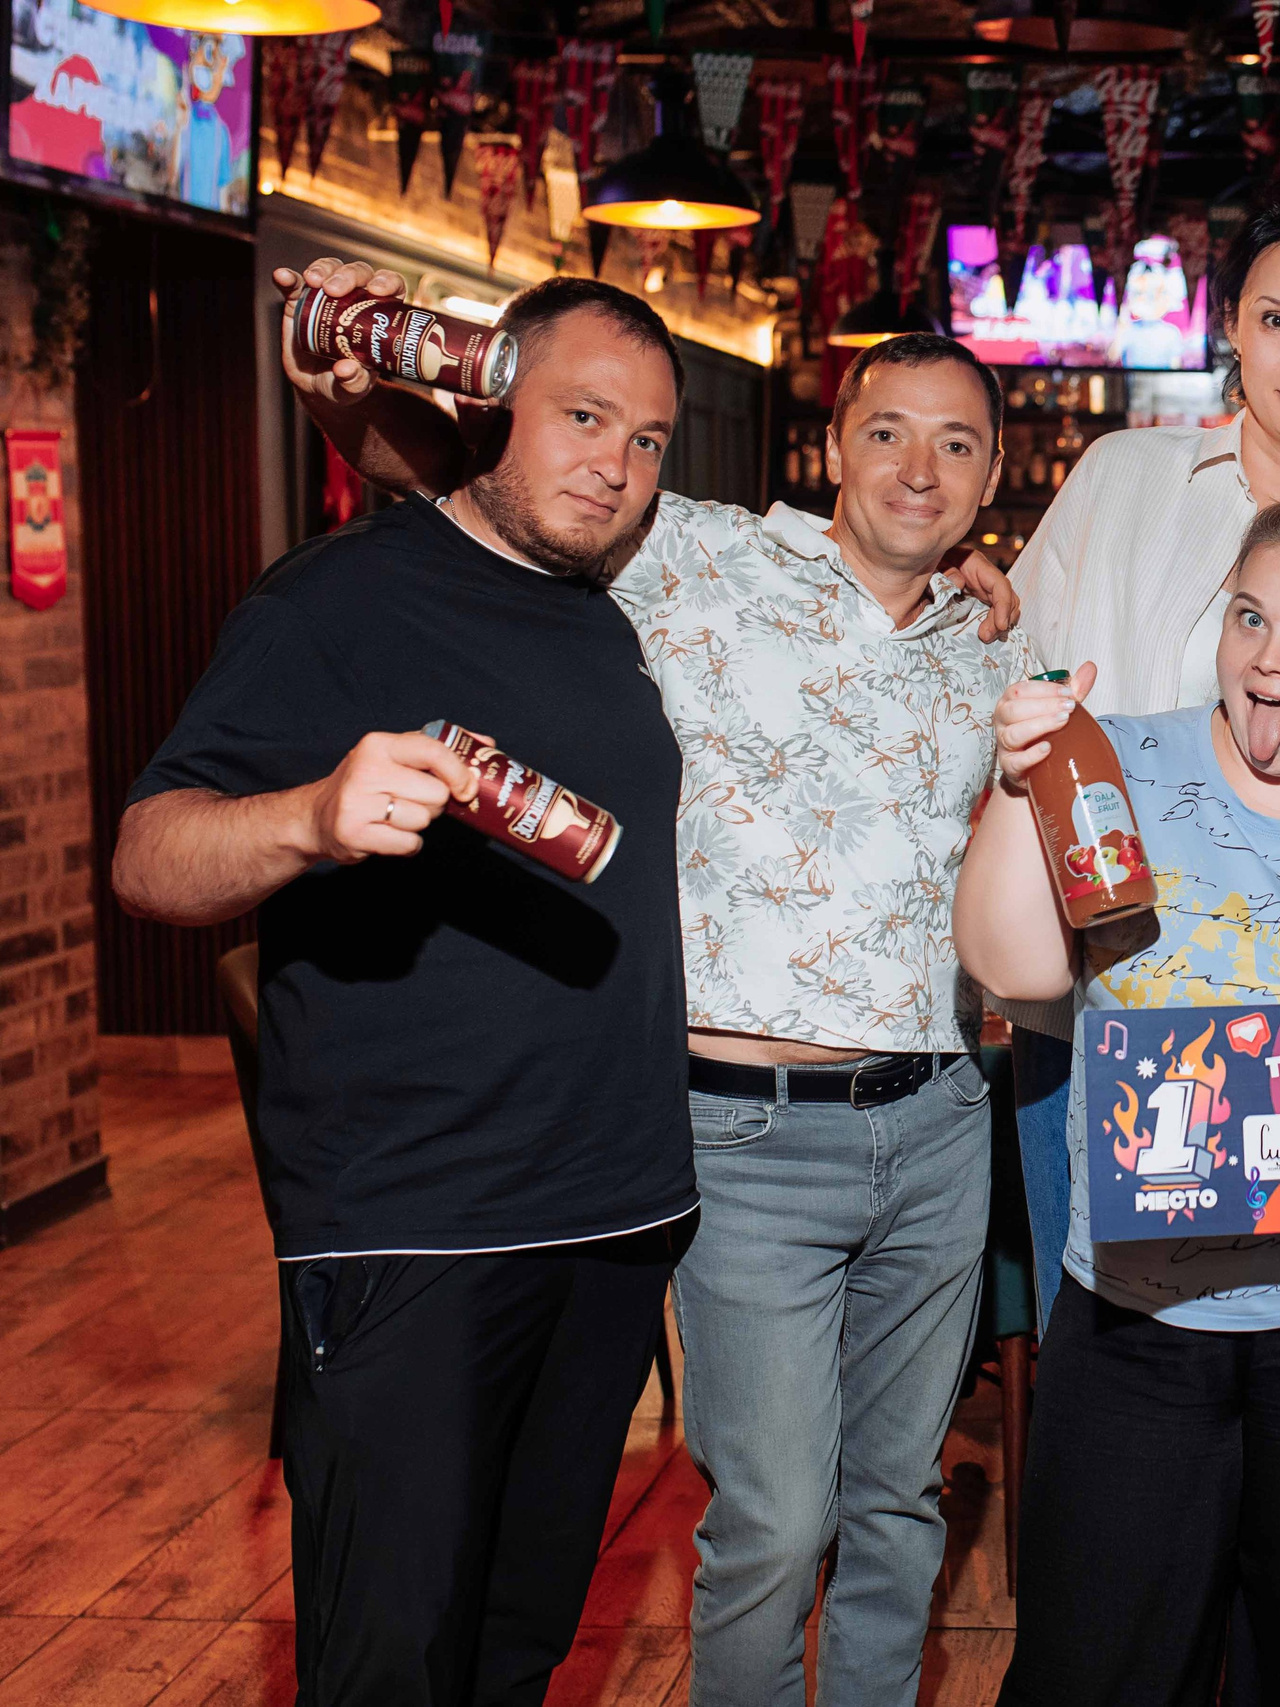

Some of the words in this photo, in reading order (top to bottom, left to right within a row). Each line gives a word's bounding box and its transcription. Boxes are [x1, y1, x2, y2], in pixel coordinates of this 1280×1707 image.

[352, 323, 364, 344] 4,0%
[371, 312, 390, 363] Pilsner
[401, 312, 431, 380] ШЫМКЕНТСКО
[1095, 791, 1116, 803] DALA
[1098, 801, 1120, 813] FRUIT
[1135, 1188, 1218, 1212] МЕСТО
